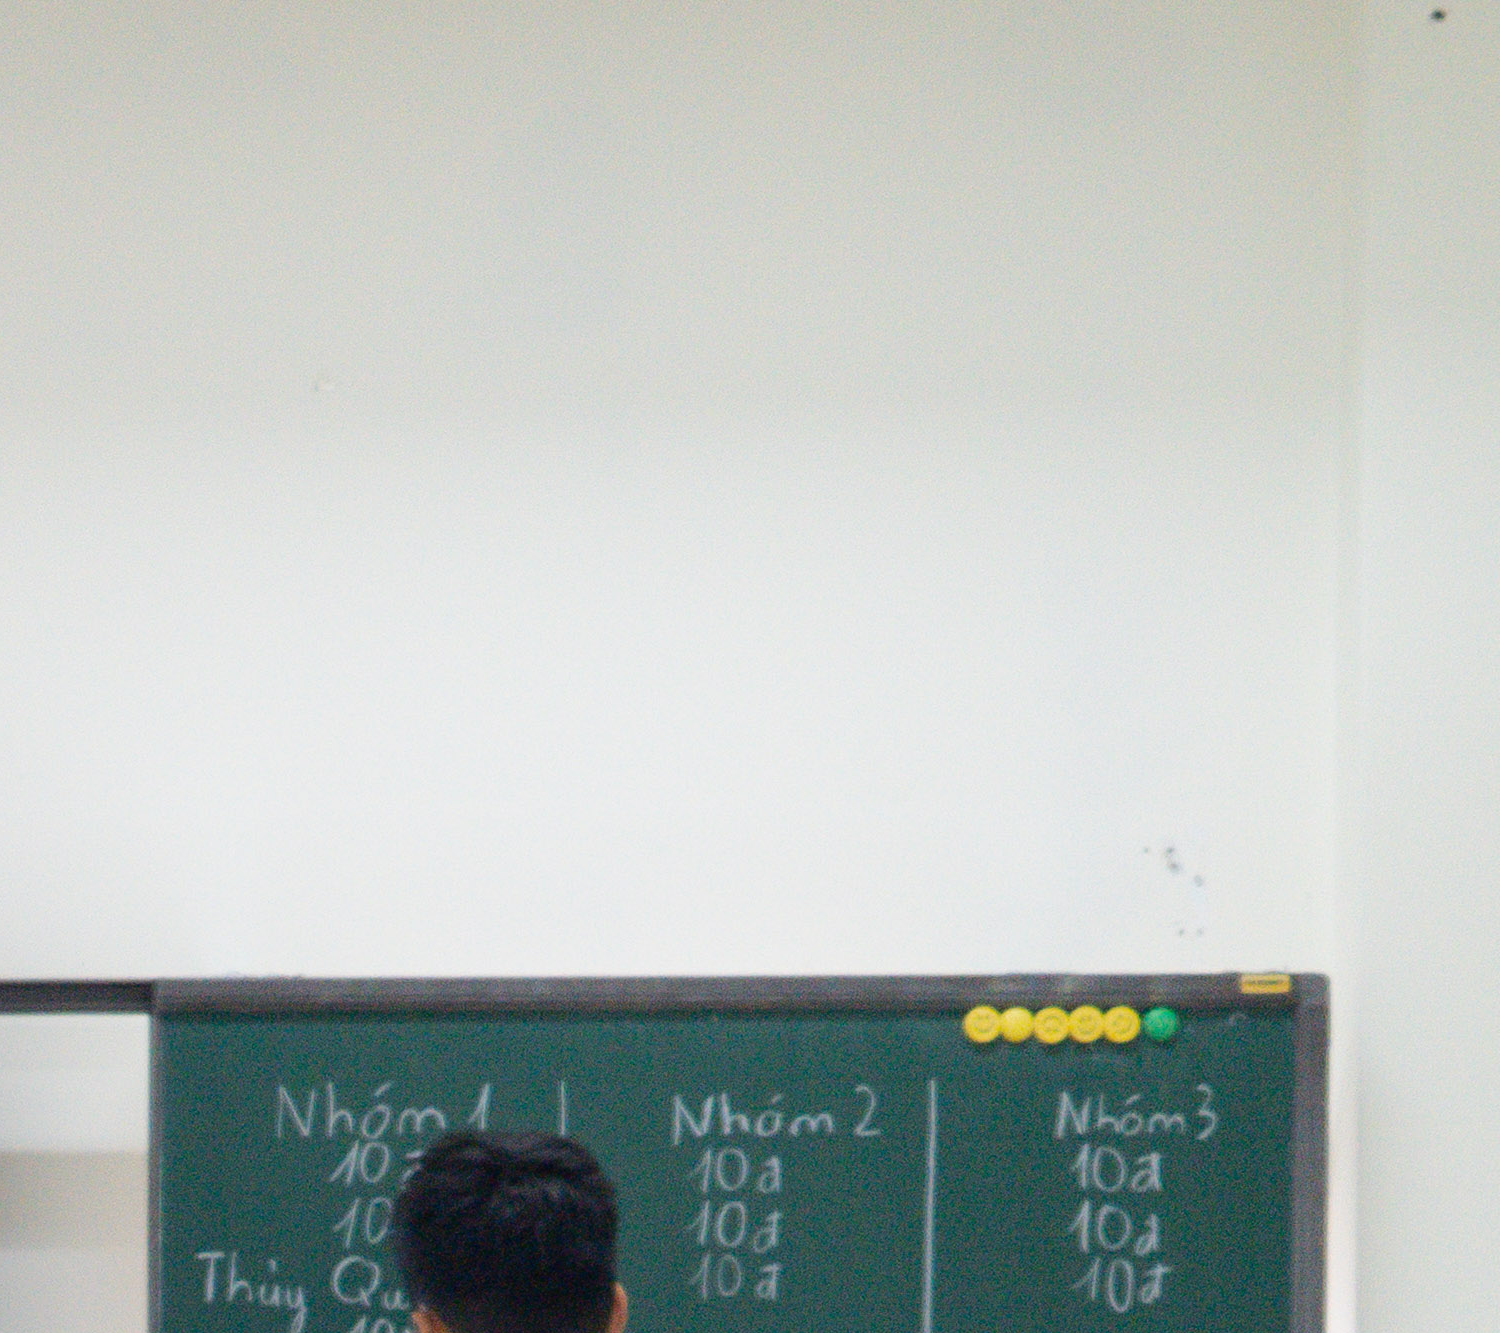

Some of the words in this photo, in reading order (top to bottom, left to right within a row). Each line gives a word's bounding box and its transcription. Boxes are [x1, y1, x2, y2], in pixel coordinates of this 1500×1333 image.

[276, 1081, 447, 1140] Nhóm
[467, 1082, 492, 1131] 1
[672, 1092, 836, 1147] Nhóm
[854, 1084, 882, 1138] 2
[1054, 1090, 1187, 1140] Nhóm
[1196, 1083, 1219, 1141] 3
